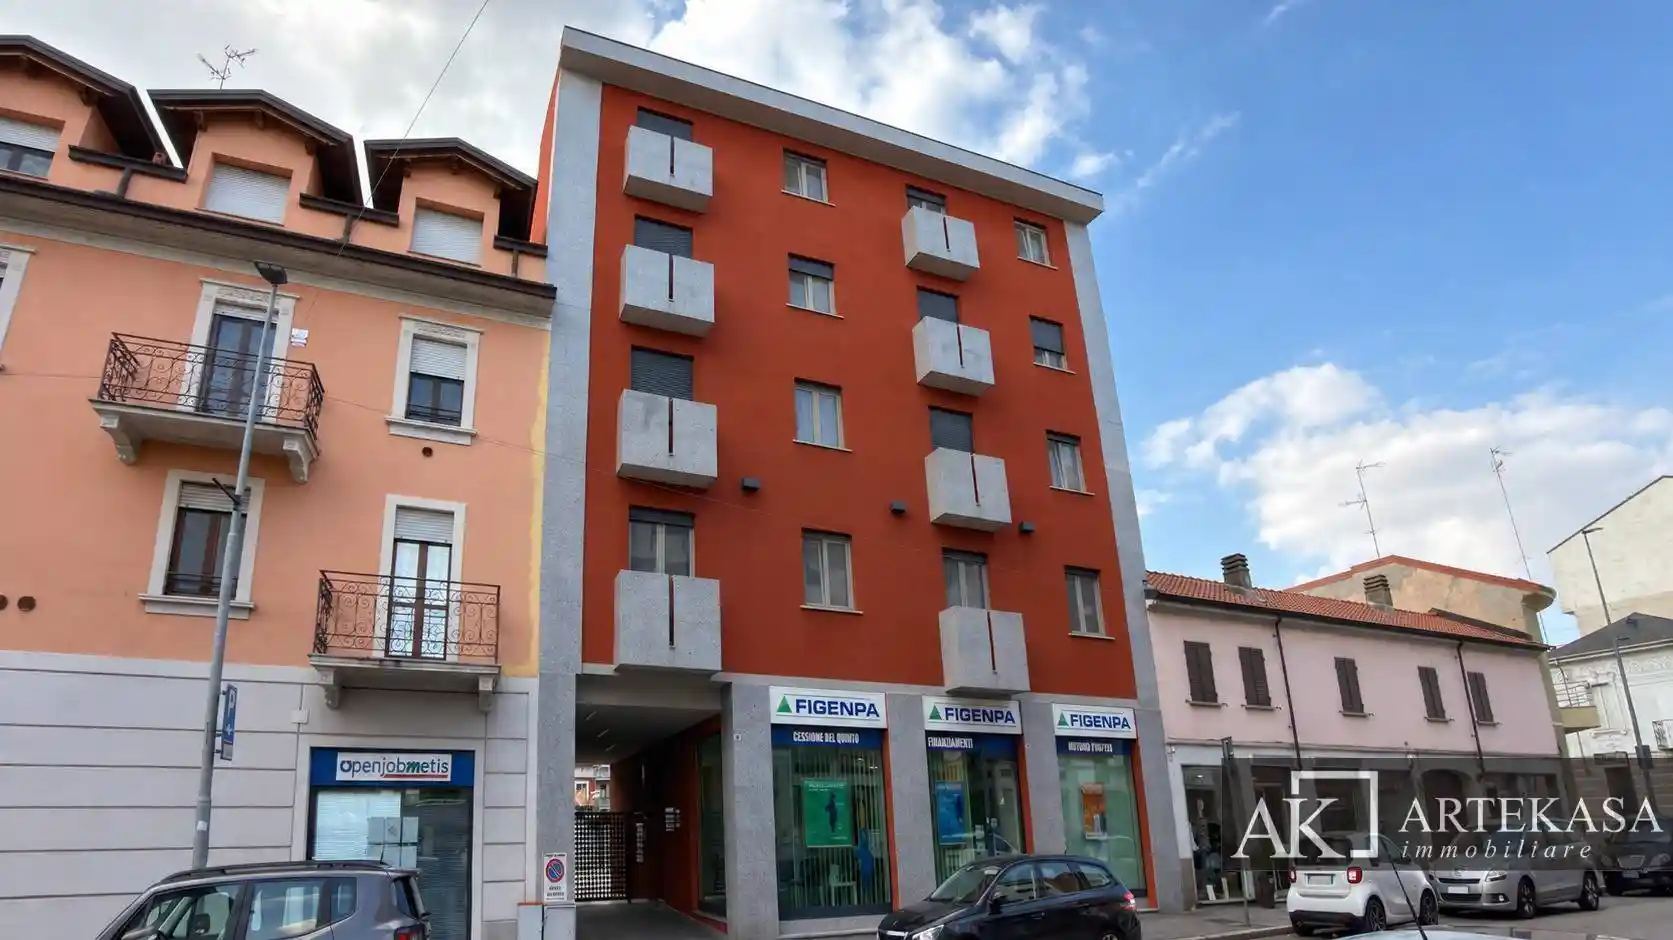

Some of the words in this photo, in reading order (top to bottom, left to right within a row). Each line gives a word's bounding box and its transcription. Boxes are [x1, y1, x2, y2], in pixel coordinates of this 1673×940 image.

[795, 698, 880, 718] FIGENPA
[944, 706, 1016, 724] FIGENPA
[1069, 713, 1132, 730] FIGENPA
[792, 731, 824, 743] CESSIONE
[339, 756, 449, 778] openjobmetis
